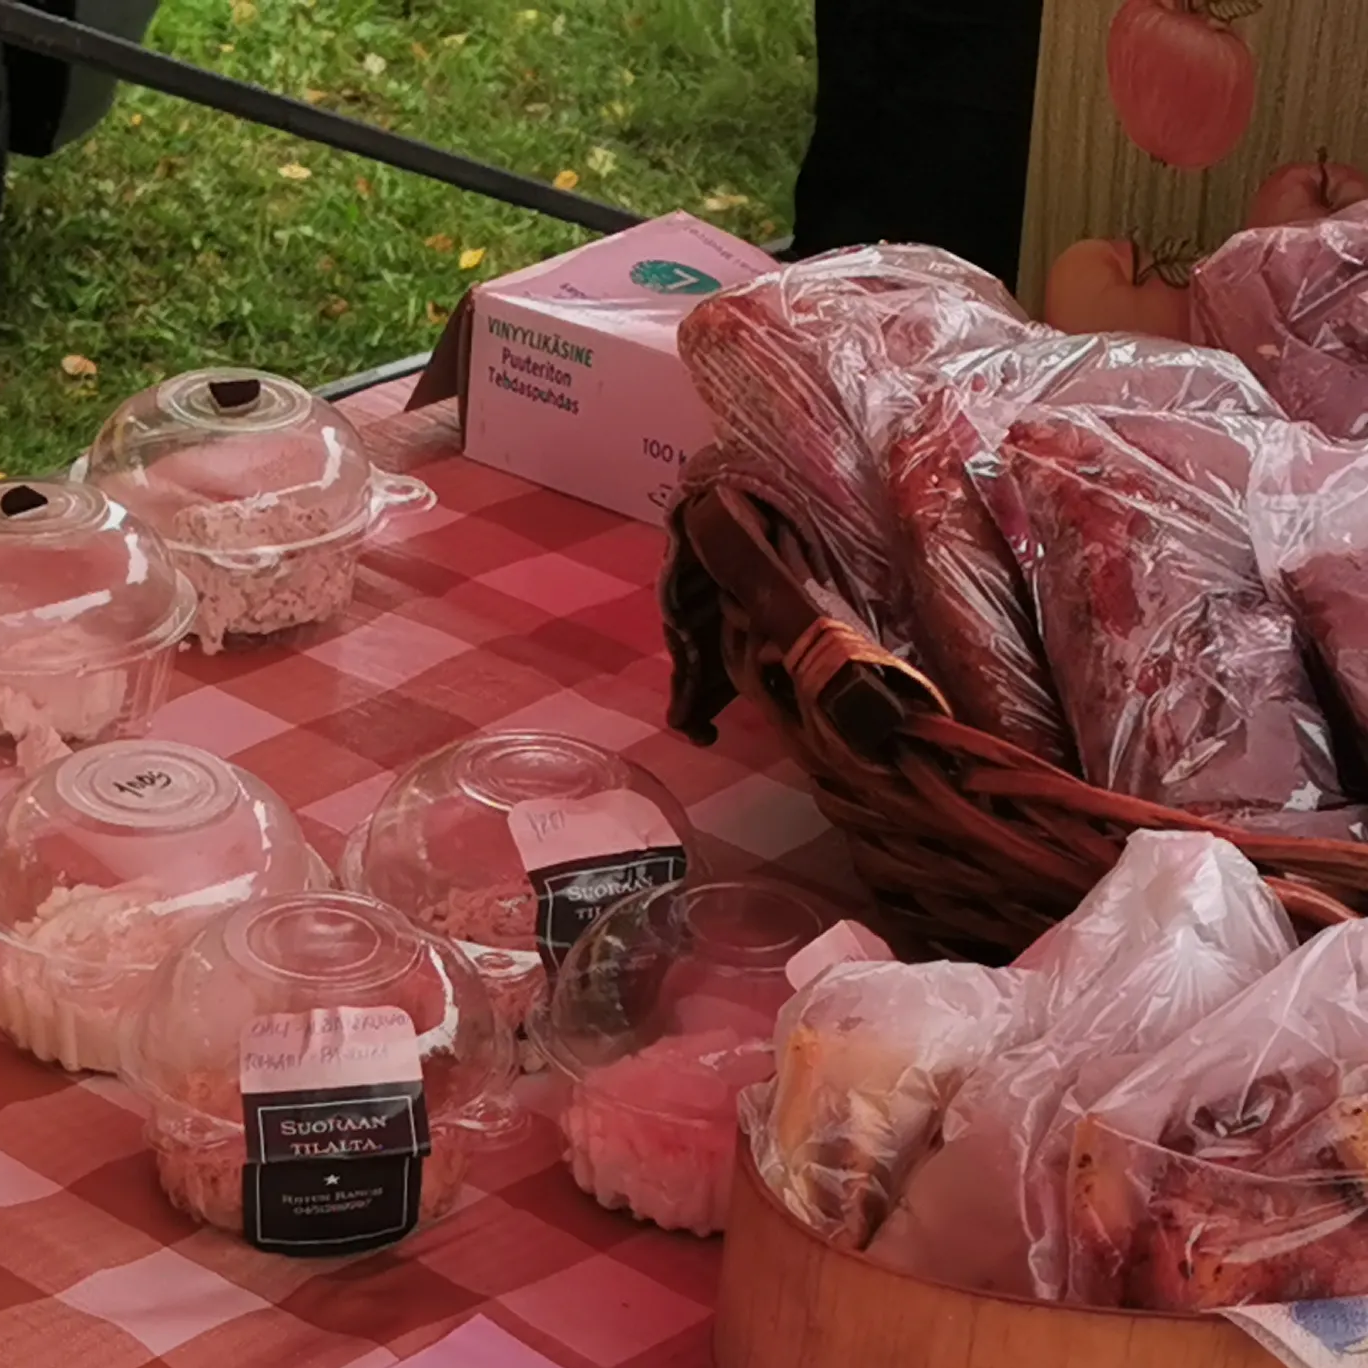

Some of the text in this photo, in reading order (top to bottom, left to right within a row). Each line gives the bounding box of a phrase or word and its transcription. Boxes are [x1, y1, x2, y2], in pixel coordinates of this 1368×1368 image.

[488, 315, 594, 369] VINYYLIKÄSINE
[488, 366, 580, 416] Tehdaspuhdas
[502, 348, 573, 389] Puuteriton
[642, 437, 674, 464] 100
